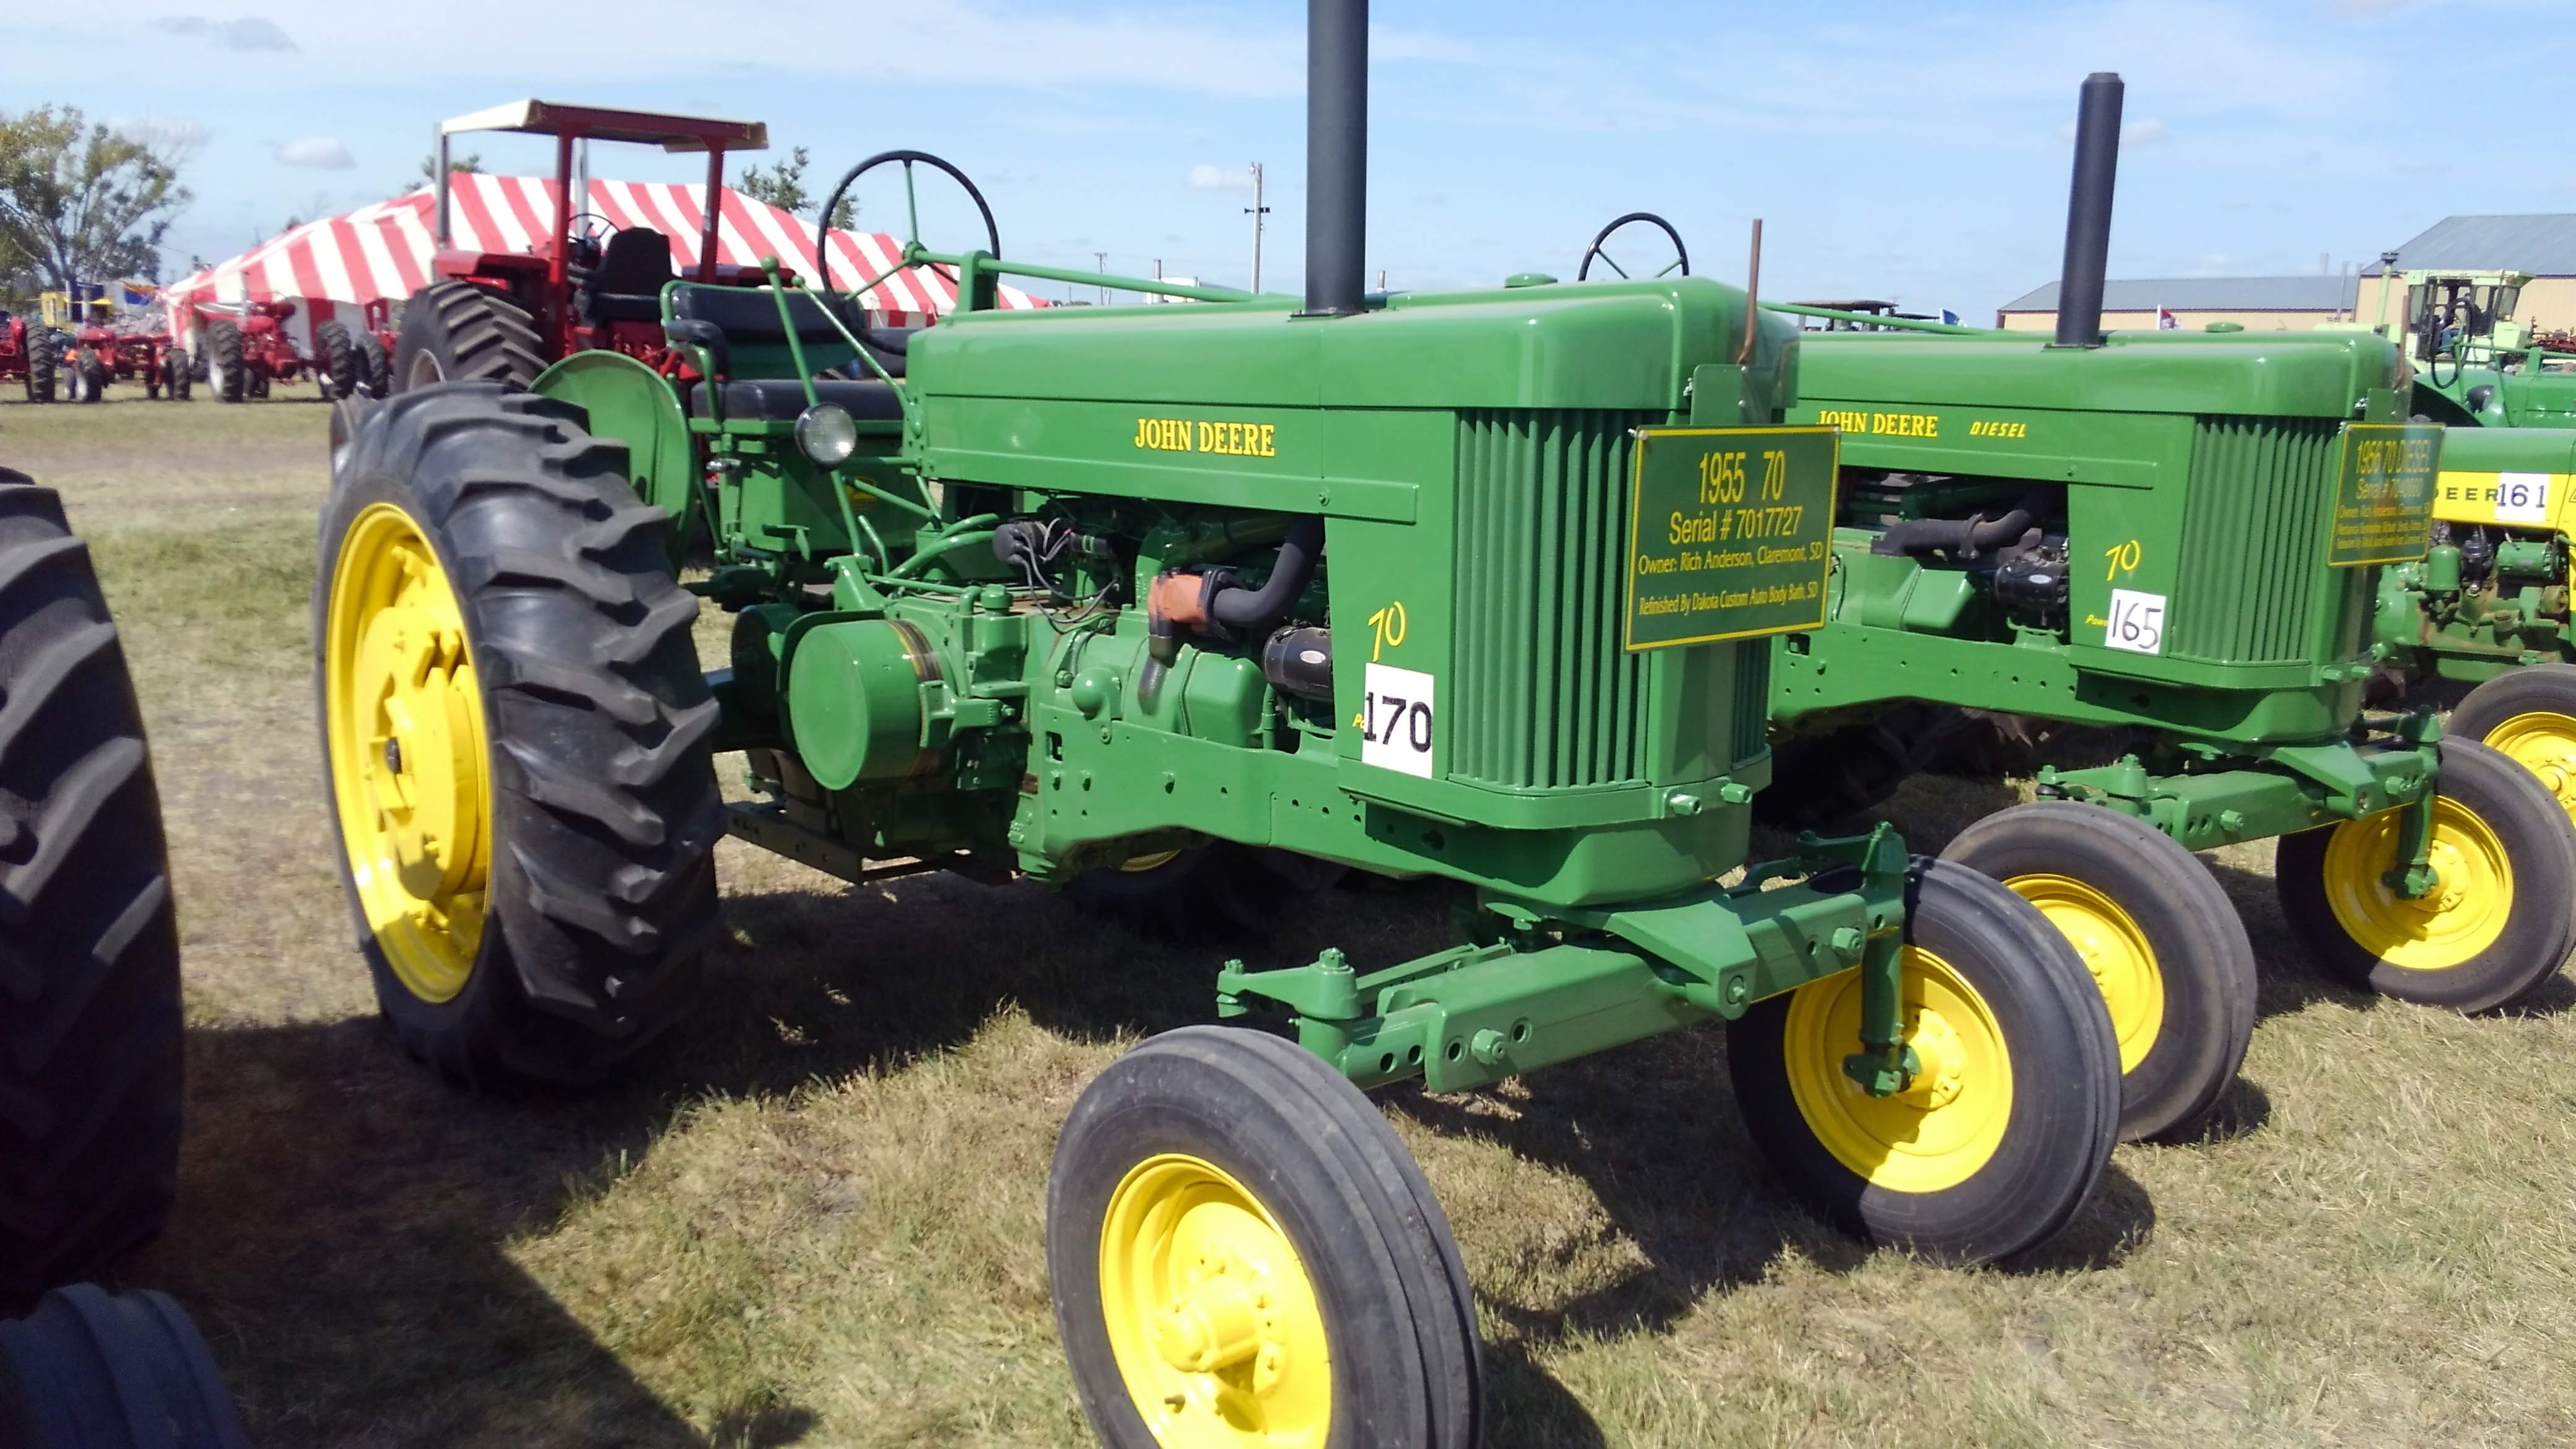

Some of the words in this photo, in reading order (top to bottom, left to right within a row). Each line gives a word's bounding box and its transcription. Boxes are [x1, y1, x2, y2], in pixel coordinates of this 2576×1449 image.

[1134, 418, 1191, 451] JOHN
[1199, 421, 1275, 456] DEERE
[1817, 411, 1868, 433] JOHN
[1872, 413, 1938, 437] DEERE
[1969, 421, 2026, 438] DIESEL
[1699, 451, 1746, 504] 1955
[1761, 450, 1786, 500] 70
[2497, 484, 2545, 508] 161
[1669, 511, 1717, 545] Serial
[1638, 555, 1677, 575] Owner:
[1680, 551, 1702, 571] Rich
[1703, 549, 1754, 568] Anderson,
[1809, 541, 1823, 560] SD
[2105, 540, 2140, 581] 70
[1680, 593, 1691, 616] By
[1692, 591, 1719, 610] Dakota
[1720, 590, 1747, 607] Custom
[1749, 587, 1767, 605] Auto
[1768, 585, 1787, 606] Body
[1807, 581, 1818, 599] SD
[1368, 601, 1405, 663] 70
[2112, 599, 2162, 650] 165
[1364, 691, 1432, 753] 170
